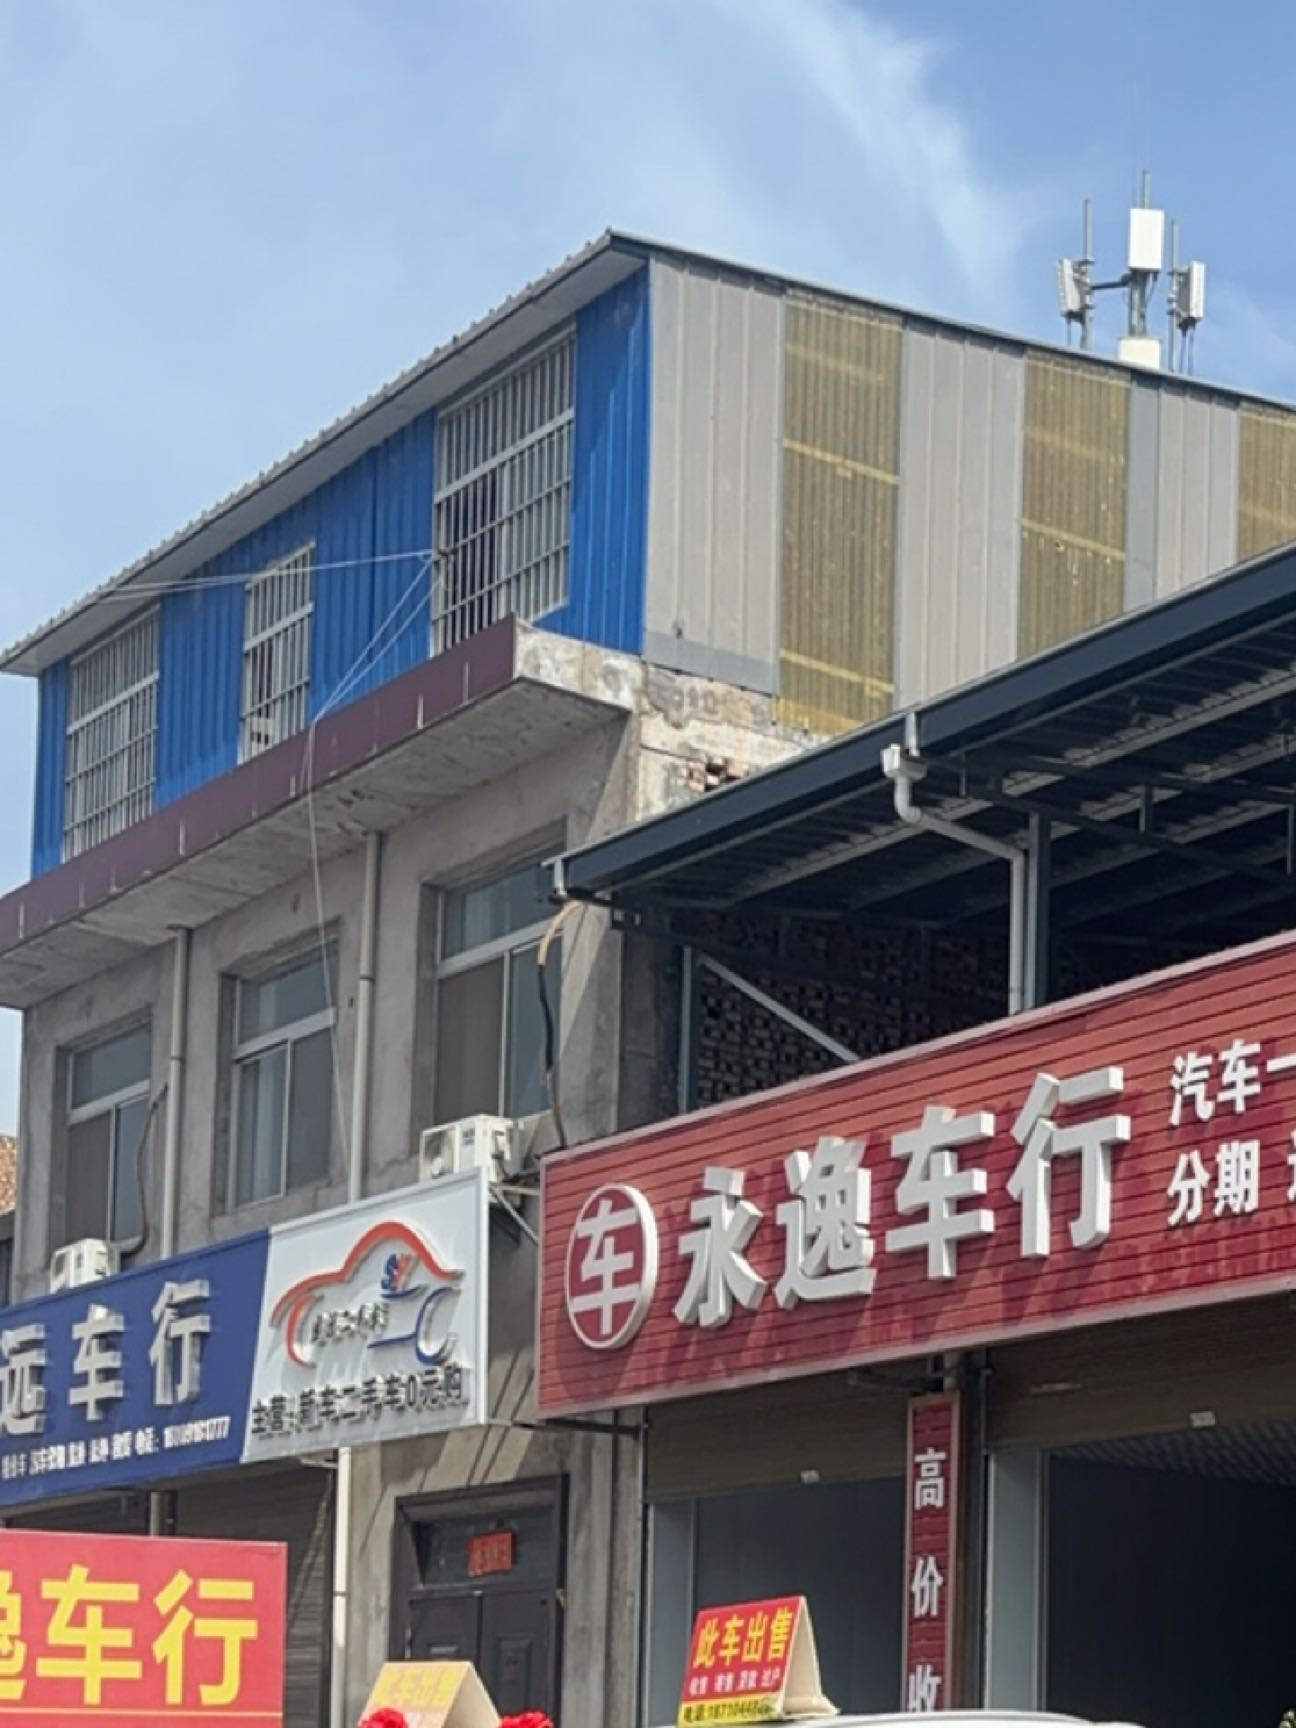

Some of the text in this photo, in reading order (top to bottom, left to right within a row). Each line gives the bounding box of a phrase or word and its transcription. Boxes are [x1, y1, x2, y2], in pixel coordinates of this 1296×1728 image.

[673, 1066, 1132, 1328] 永逸车行
[1167, 1139, 1260, 1226] 分期
[0, 1280, 211, 1435] 远车行
[0, 1563, 259, 1706] 车行
[692, 1606, 793, 1669] 此车出售
